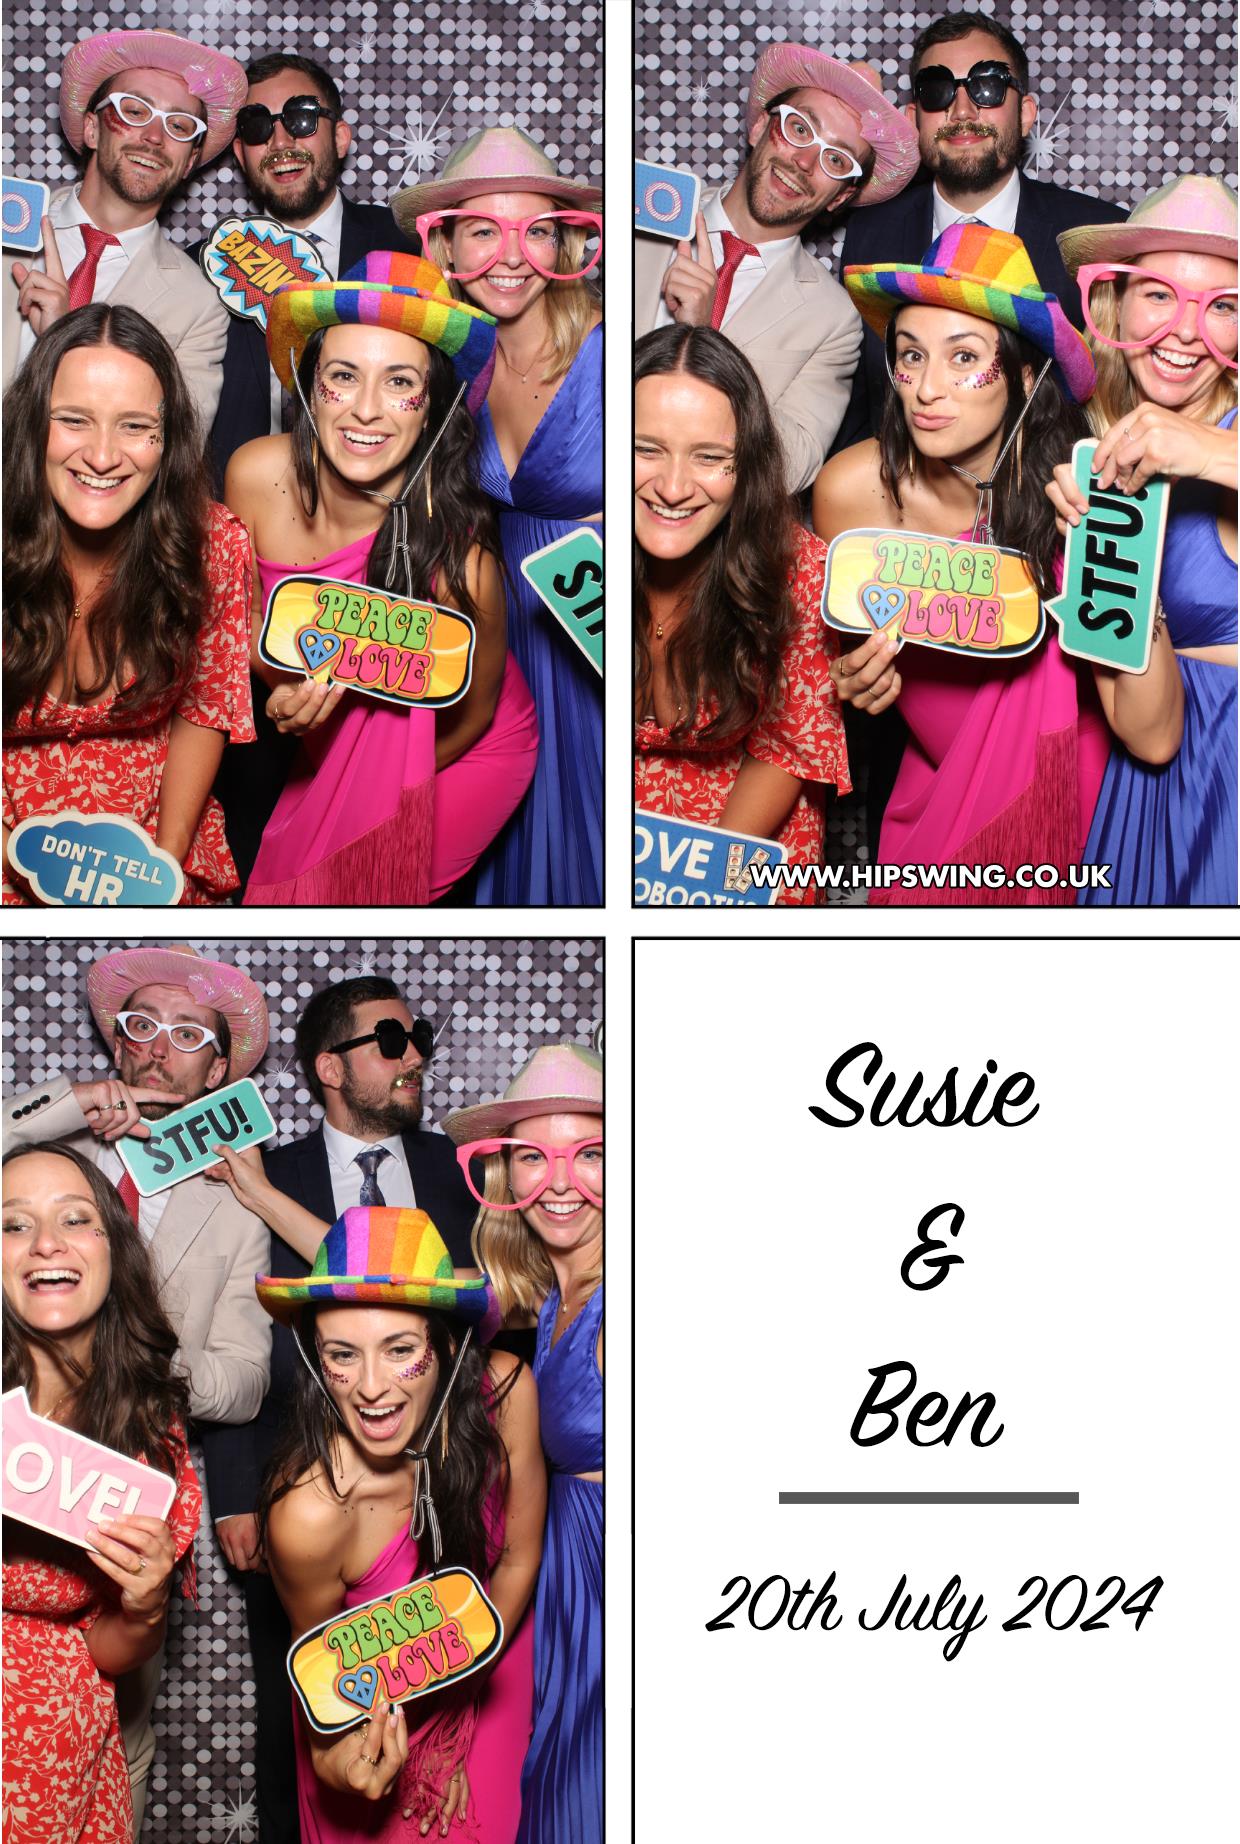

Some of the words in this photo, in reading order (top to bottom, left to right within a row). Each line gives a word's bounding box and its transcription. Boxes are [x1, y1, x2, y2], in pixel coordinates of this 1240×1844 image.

[877, 540, 996, 597] PEACE
[316, 588, 433, 650] PEACE
[902, 590, 1000, 644] LOVE
[333, 638, 431, 695] LOVE
[41, 834, 107, 867] DON'T
[113, 854, 163, 885] TELL
[64, 865, 124, 905] HR
[142, 1097, 254, 1175] STFU!
[327, 1585, 444, 1670] PEACE
[376, 1622, 470, 1699] LOVE
